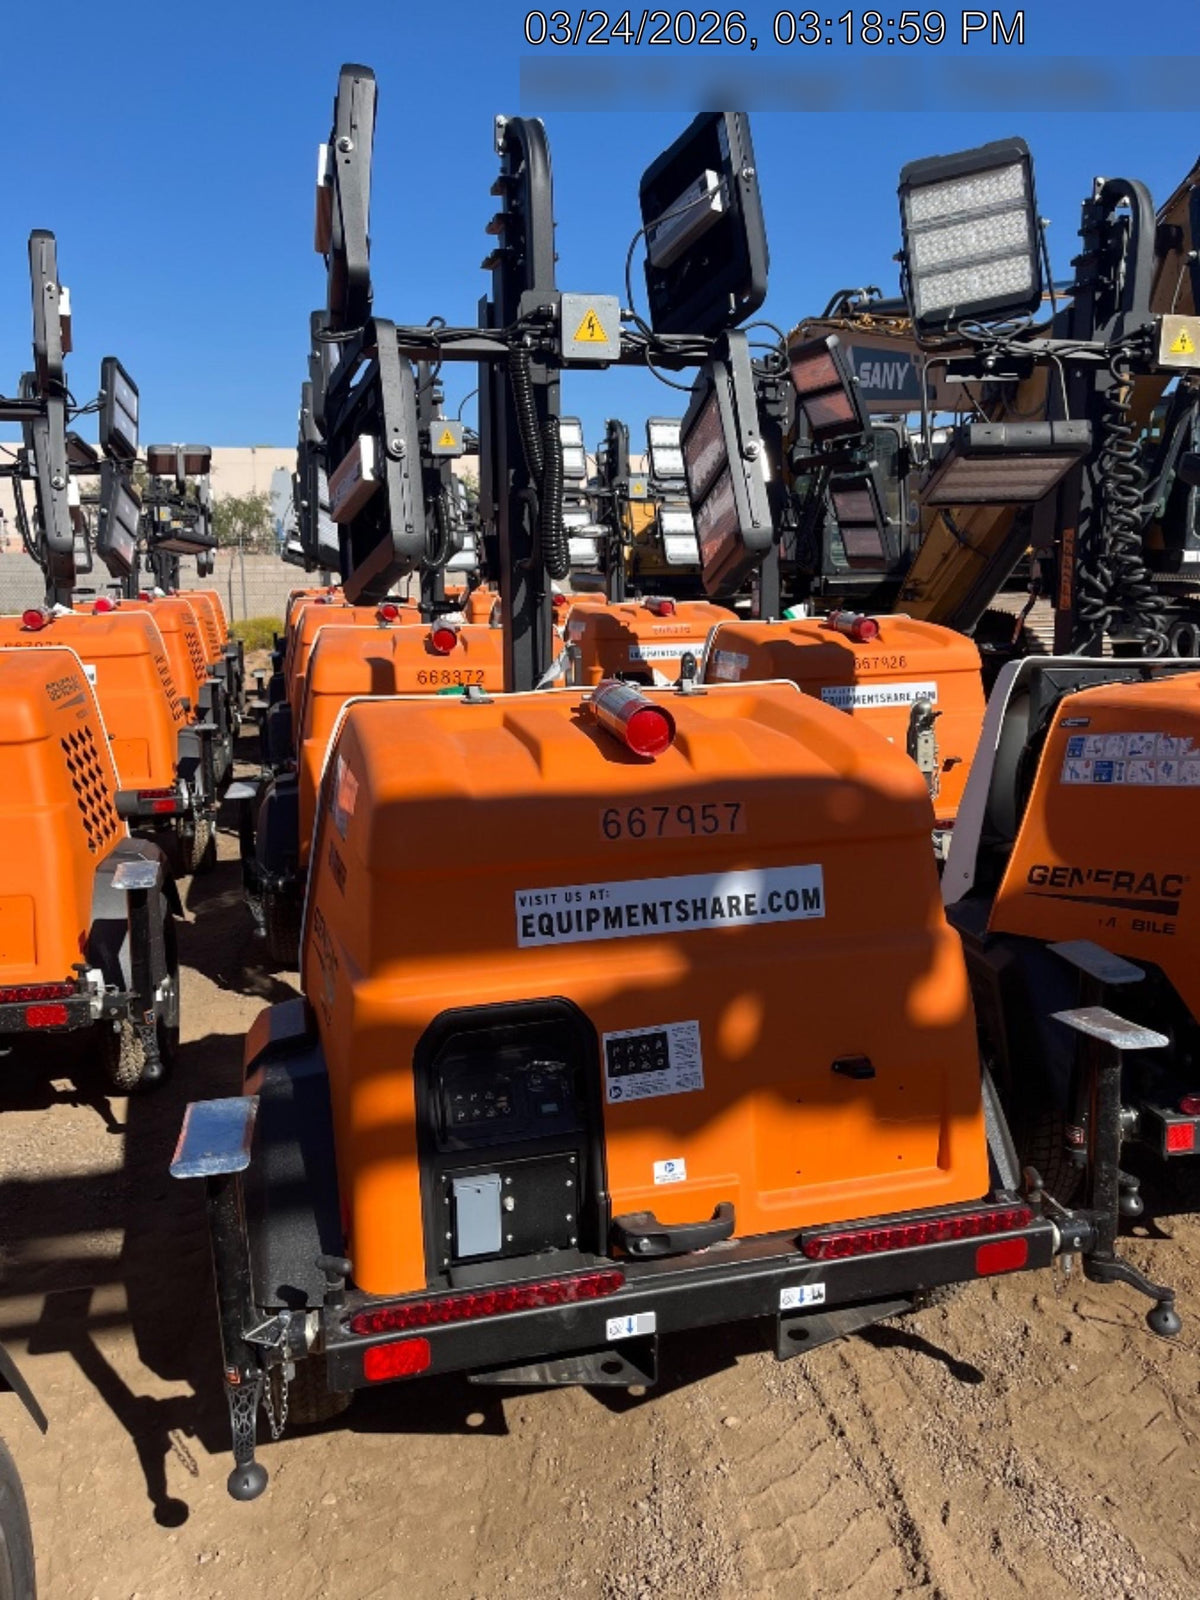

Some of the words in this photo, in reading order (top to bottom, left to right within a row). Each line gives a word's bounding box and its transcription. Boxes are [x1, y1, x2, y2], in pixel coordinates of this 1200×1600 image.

[859, 361, 910, 390] SANY
[417, 669, 485, 685] 668372
[602, 802, 741, 839] 667957
[518, 893, 557, 907] VISIT
[564, 891, 582, 903] US
[589, 888, 610, 901] AT:
[521, 887, 821, 938] EQUIPMENTSHARE.COM
